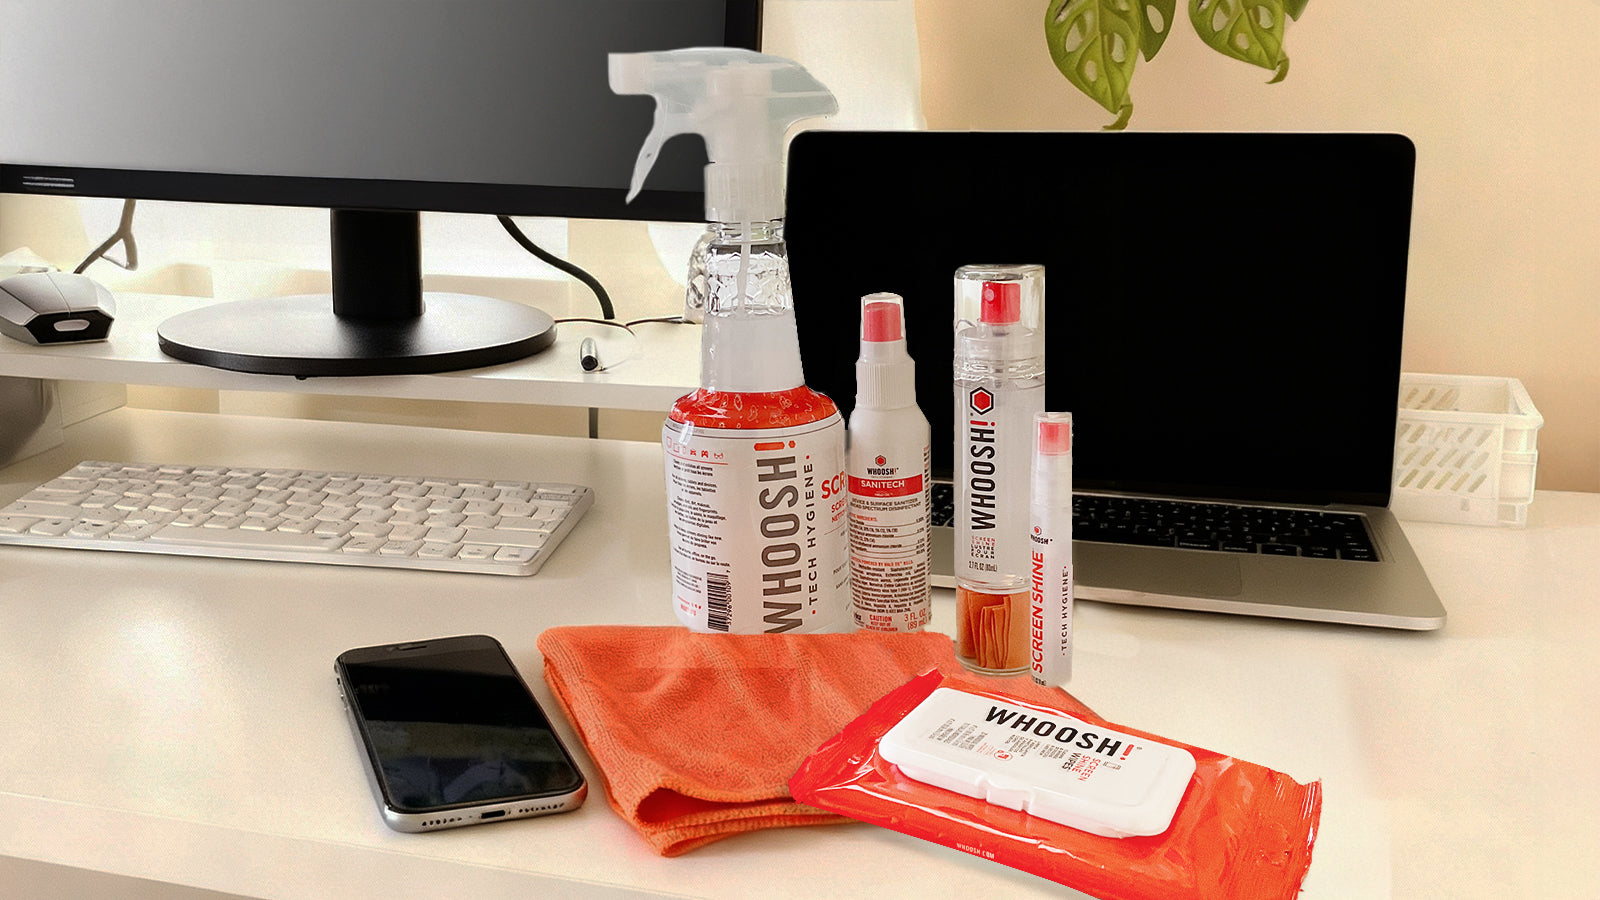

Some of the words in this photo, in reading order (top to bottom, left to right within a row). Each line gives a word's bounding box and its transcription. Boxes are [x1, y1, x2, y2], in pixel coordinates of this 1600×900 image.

[861, 480, 905, 489] SANITECH
[969, 419, 996, 530] WHOOSH!
[803, 463, 817, 549] HYGIENE
[753, 439, 803, 634] WHOOSH!
[808, 557, 818, 606] TECH
[1031, 549, 1044, 605] SHINE
[1061, 569, 1069, 619] HYGIENE
[869, 614, 893, 622] CAUTION
[904, 614, 909, 622] 3
[1031, 605, 1044, 674] SCREEN
